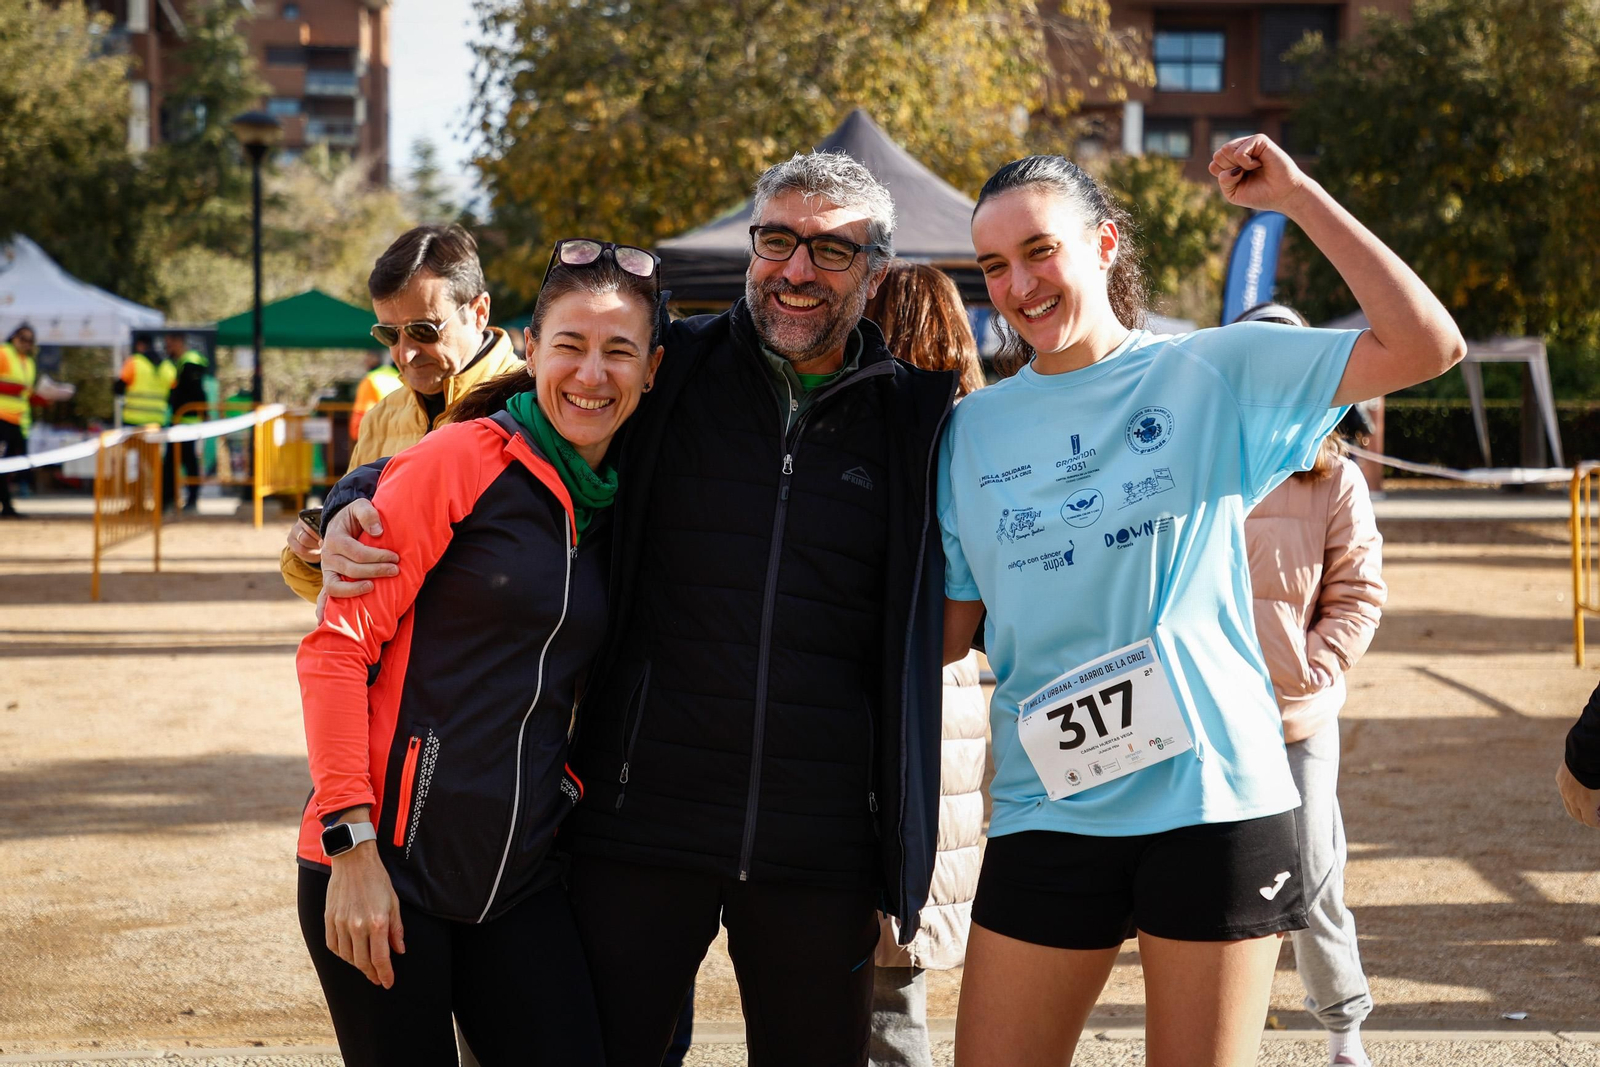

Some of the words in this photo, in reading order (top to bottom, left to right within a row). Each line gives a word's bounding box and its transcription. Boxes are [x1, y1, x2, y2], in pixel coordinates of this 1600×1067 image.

[1002, 464, 1032, 478] SOLIDARIA
[1066, 460, 1086, 472] 2031
[1104, 520, 1154, 548] DOWN
[1040, 550, 1061, 560] cáncer
[1043, 557, 1064, 572] aupa
[1030, 694, 1046, 709] MILLA
[1048, 681, 1072, 698] URBANA
[1079, 668, 1104, 684] BARRIO
[1104, 662, 1115, 674] DE
[1115, 658, 1126, 669] LA
[1126, 650, 1146, 664] CRUZ
[1046, 679, 1132, 750] 317
[1080, 744, 1099, 754] CARMEN
